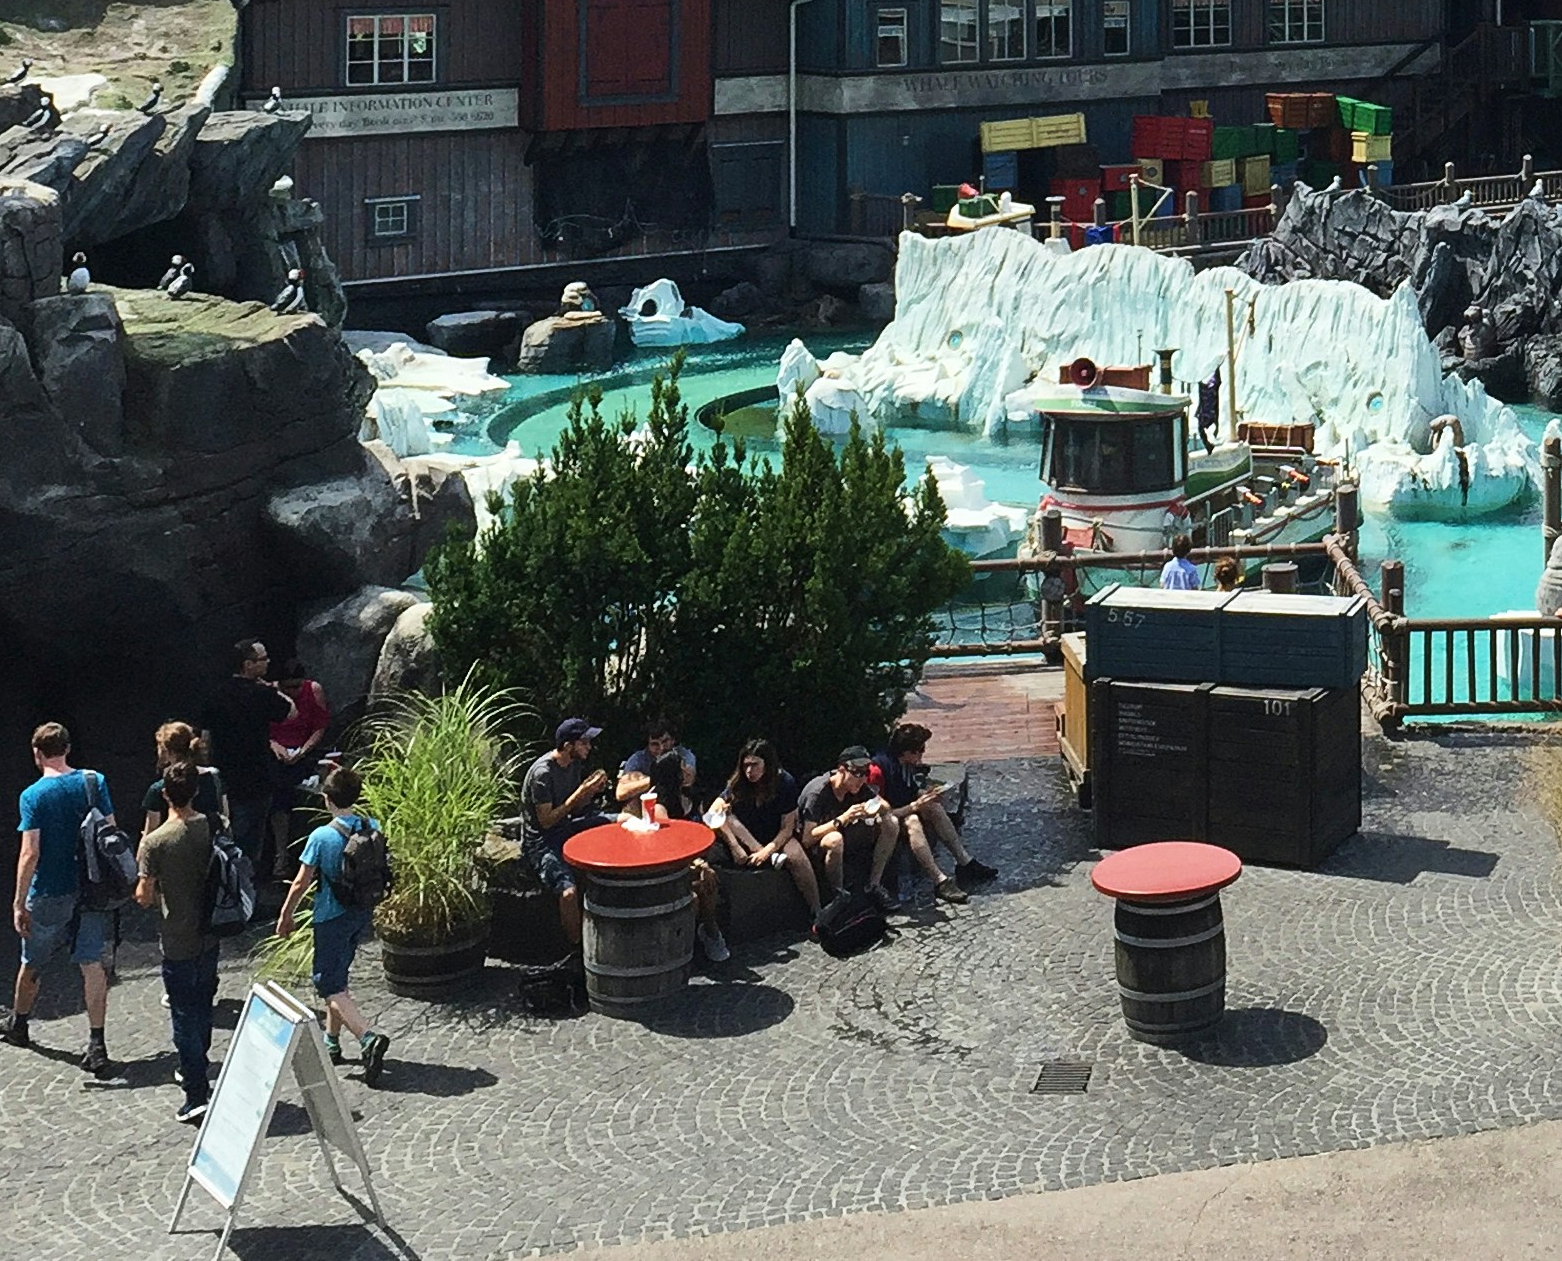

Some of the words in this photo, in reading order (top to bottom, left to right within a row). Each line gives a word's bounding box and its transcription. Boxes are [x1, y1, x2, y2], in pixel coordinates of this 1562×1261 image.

[332, 96, 432, 113] INFORMATION
[436, 93, 493, 108] CENTER
[1263, 699, 1291, 716] 101
